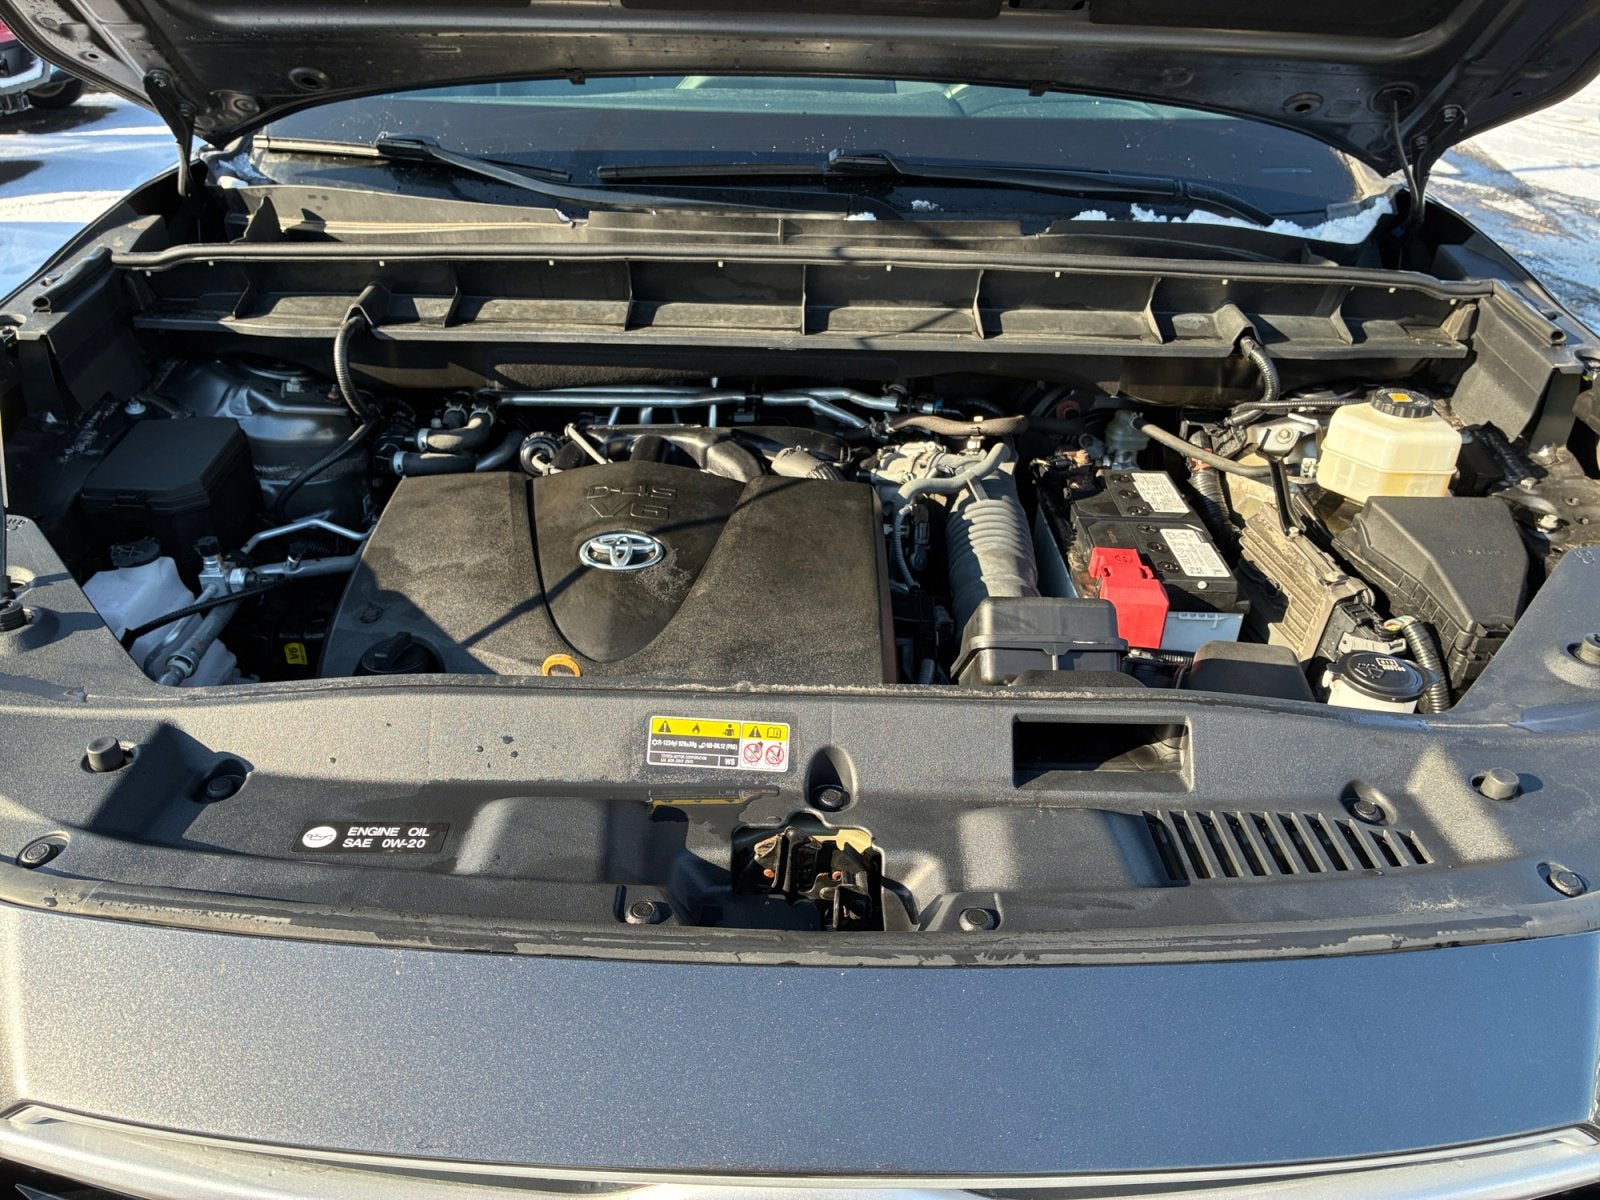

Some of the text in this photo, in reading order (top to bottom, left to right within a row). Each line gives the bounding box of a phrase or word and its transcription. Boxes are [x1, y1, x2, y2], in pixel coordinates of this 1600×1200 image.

[589, 500, 670, 520] V6
[724, 758, 736, 766] WS
[347, 826, 430, 837] ENGINE OIL
[342, 838, 426, 848] SAE 0W-20
